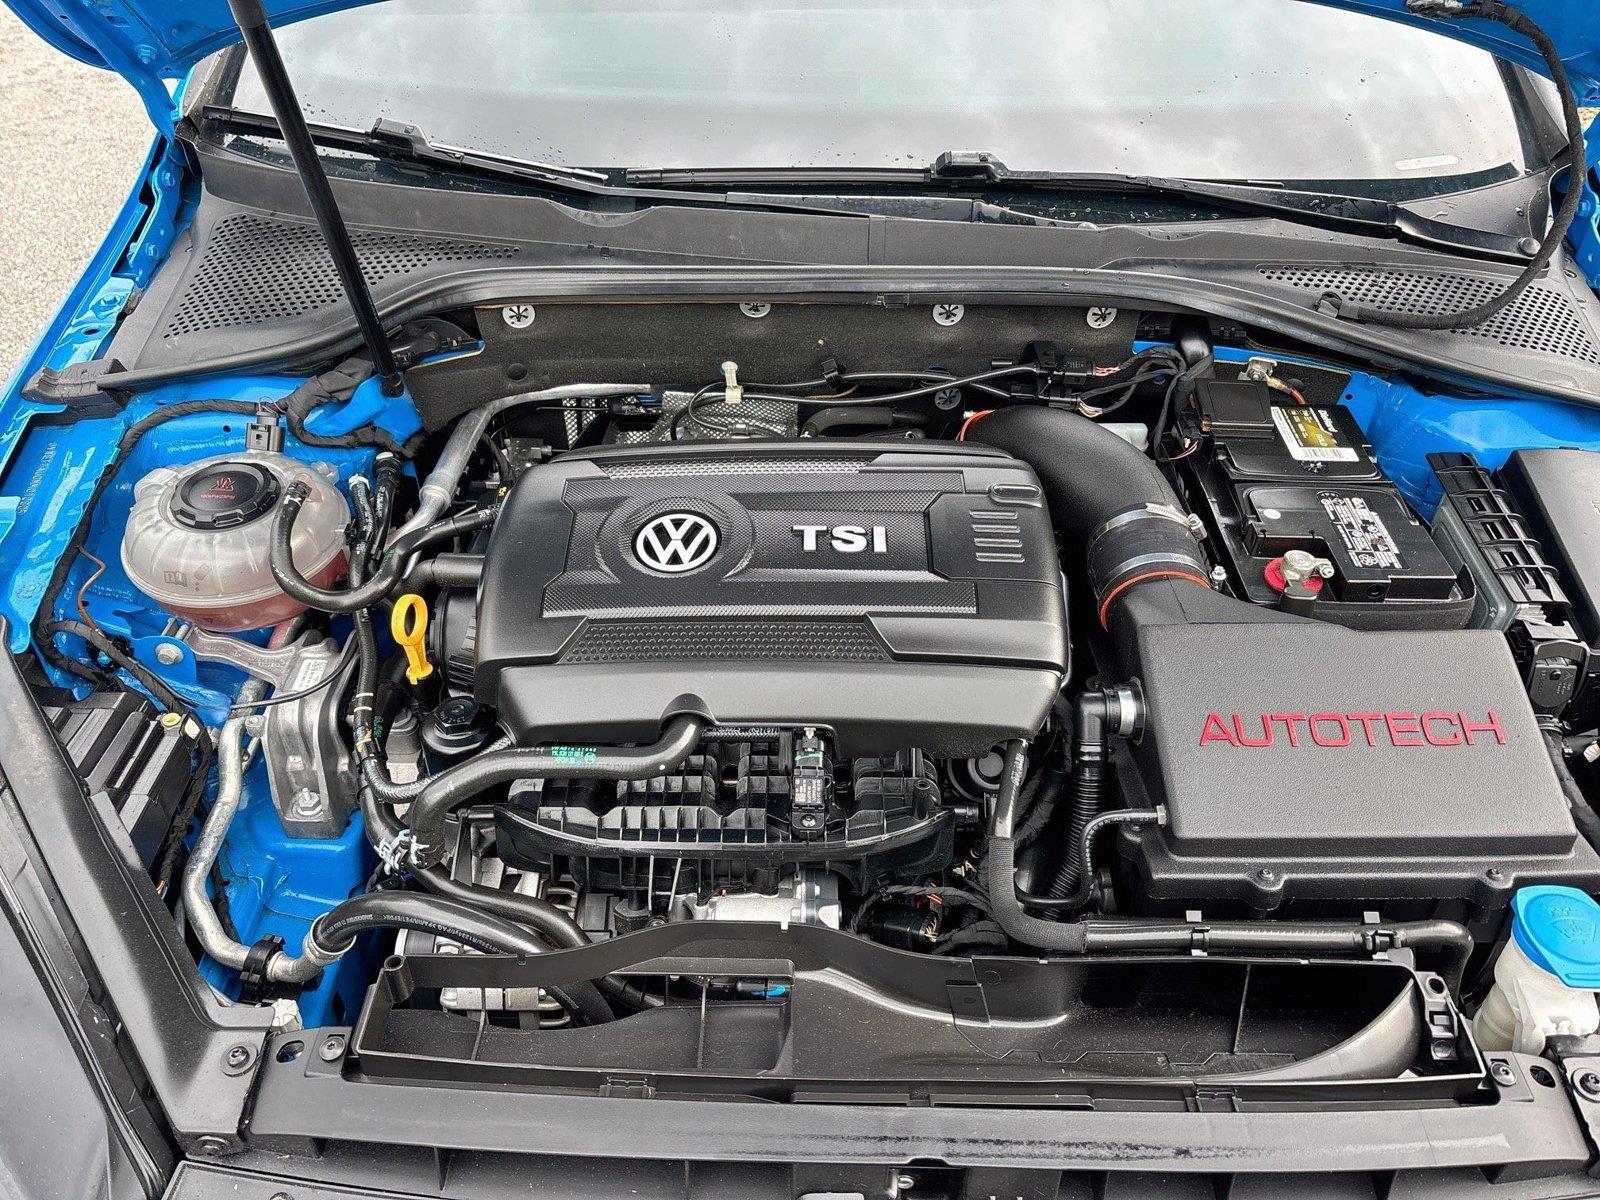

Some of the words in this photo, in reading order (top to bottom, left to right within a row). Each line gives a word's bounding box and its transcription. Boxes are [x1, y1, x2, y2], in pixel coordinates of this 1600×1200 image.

[636, 513, 718, 573] VW
[792, 525, 887, 553] TSI
[1200, 709, 1507, 748] AUTOTECH
